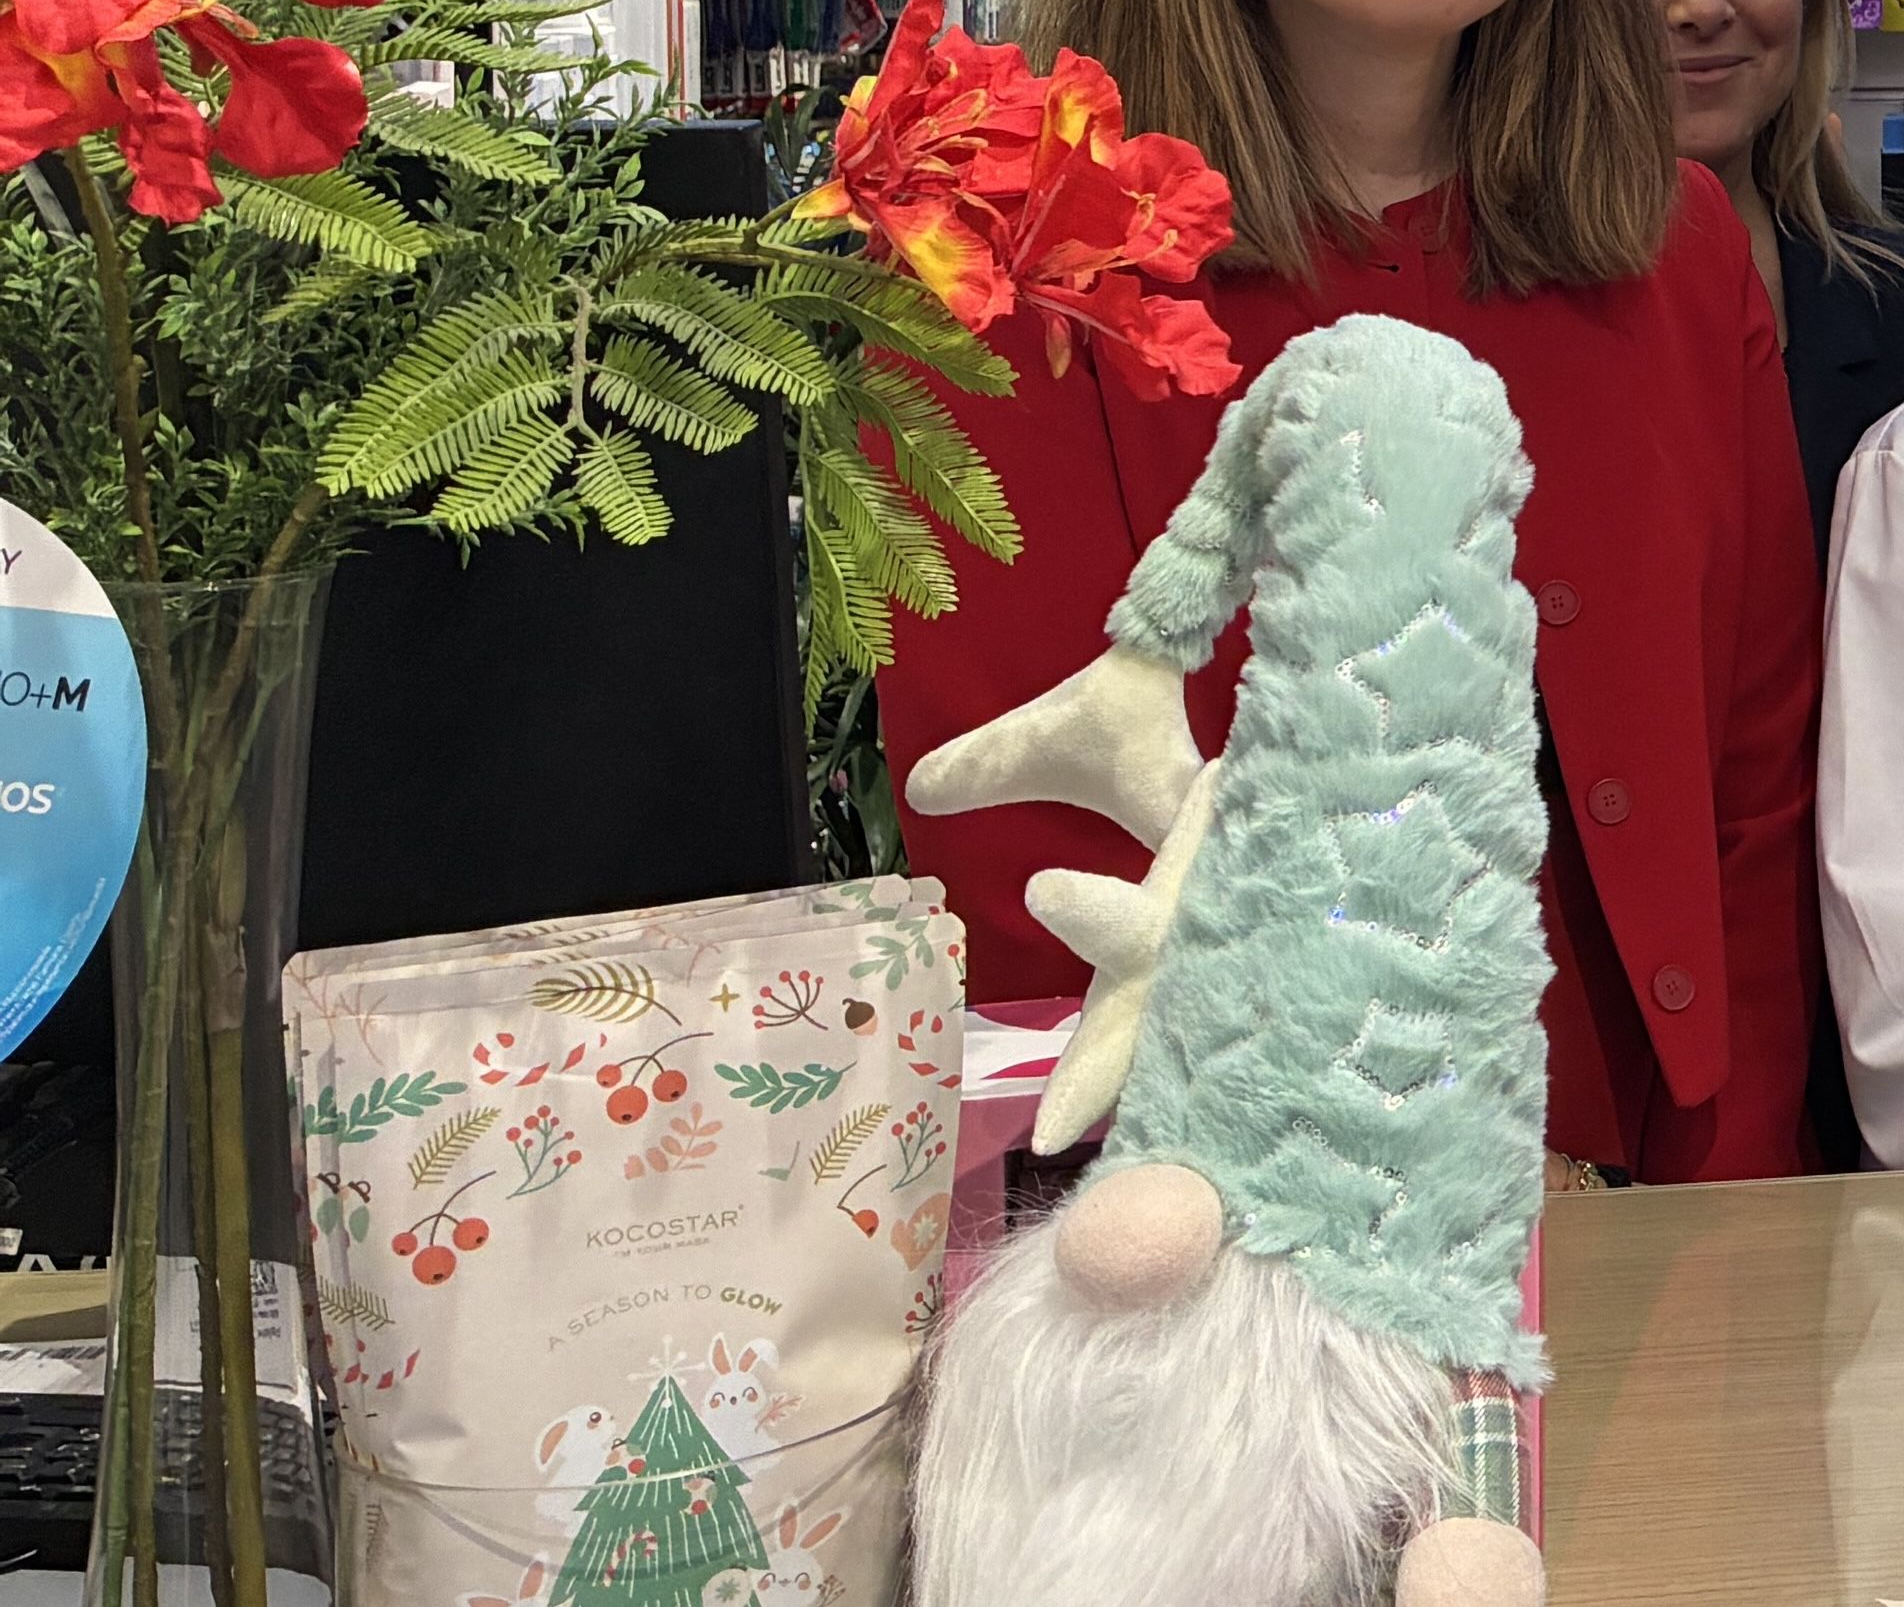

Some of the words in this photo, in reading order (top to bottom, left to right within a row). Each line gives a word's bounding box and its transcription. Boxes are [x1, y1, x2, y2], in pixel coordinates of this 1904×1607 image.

[0, 670, 91, 713] O+M
[586, 1209, 738, 1248] KOCOSTAR
[547, 1331, 563, 1351] A
[566, 1285, 670, 1335] SEASON
[681, 1283, 713, 1301] TO
[719, 1284, 783, 1317] GLOW
